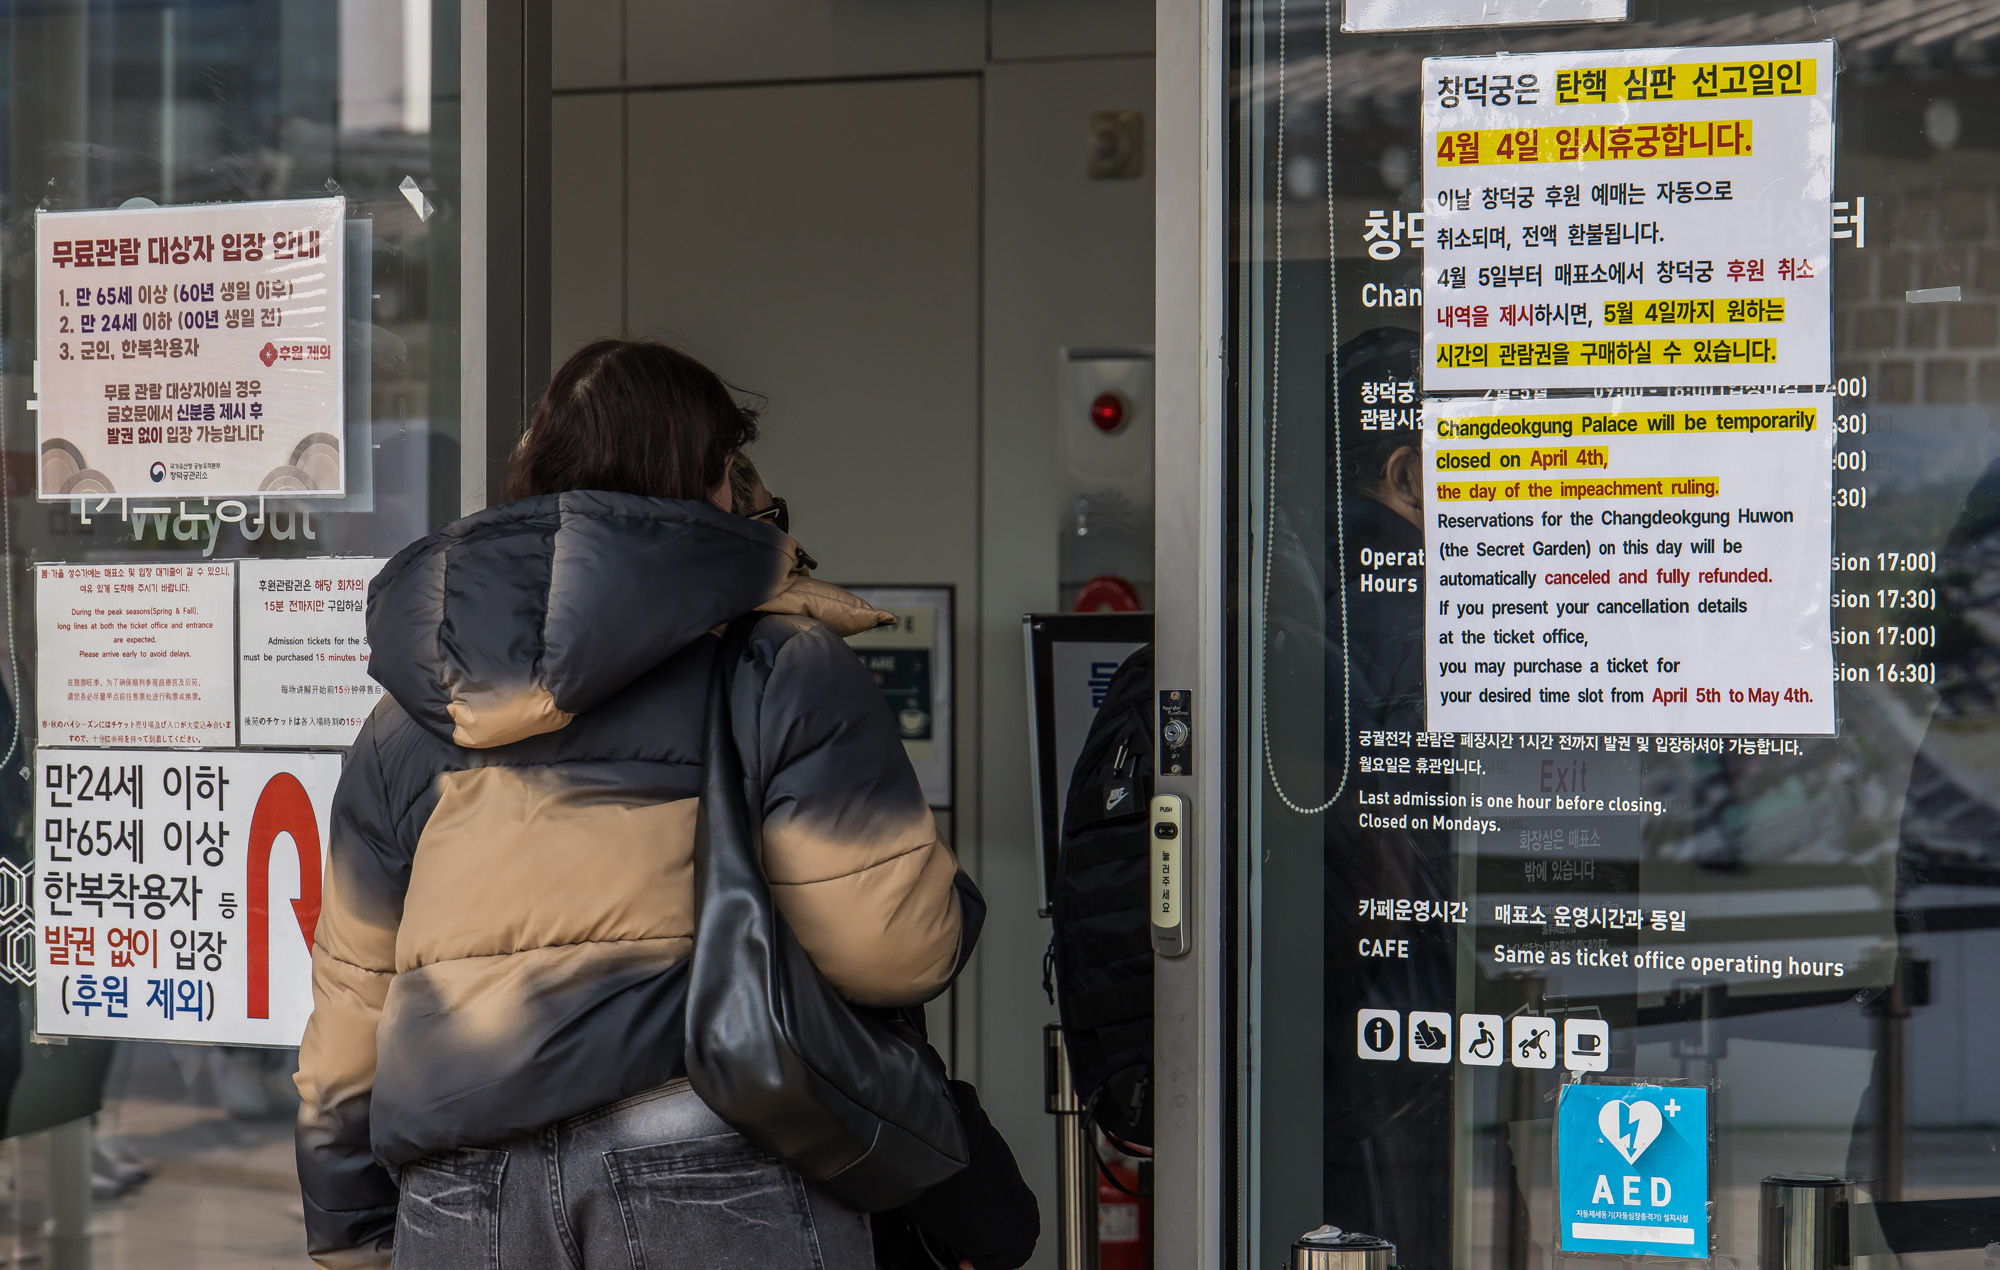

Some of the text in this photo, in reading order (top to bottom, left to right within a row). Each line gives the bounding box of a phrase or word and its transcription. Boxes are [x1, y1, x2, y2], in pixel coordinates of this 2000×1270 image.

[1438, 61, 1801, 108] 창덕궁은 탄핵 심판 선고일인
[1438, 122, 1751, 164] 4월 4일 임시휴궁합니다.
[1438, 181, 1733, 211] 이날 창덕궁 후원 예매는 자동으로
[53, 230, 319, 268] 무료관람 대상자 입장 안내
[1437, 226, 1511, 251] 취소되며,
[1523, 225, 1556, 247] 전액
[1568, 222, 1664, 246] 환불됩니다.
[1438, 258, 1814, 289] 4월 5일부터 매표소에서 창덕궁 후원 취소
[59, 280, 293, 306] 1. 만 65세 이상 (60년 생일 이후)
[60, 308, 282, 333] 2. 만 24세 이하 (00년 생일 전)
[1438, 299, 1784, 328] 내역을 제시하시면, 5월 4일까지 원하는
[60, 338, 199, 360] 3. 군인, 한복착용자
[279, 345, 330, 361] 후원 제외
[1437, 339, 1775, 367] 시간의 관람권을 구매하실 수 있습니다.
[105, 380, 261, 401] 무료 관람 대상자이실 경우
[108, 402, 262, 422] 금호문에서 신분증 제시 후
[1438, 418, 1572, 438] Changdeokgung
[1583, 416, 1637, 432] Palace
[1647, 414, 1674, 431] will
[1685, 414, 1706, 430] be
[1716, 411, 1815, 433] temporarily
[108, 425, 264, 444] 발권 없이 입장 가능합니다
[1437, 449, 1607, 470] closed on April 4th,
[170, 471, 207, 481] 창덕궁관리소
[1437, 479, 1718, 501] the day of the impeachment ruling.
[1878, 551, 1935, 573] 17:00)
[1361, 574, 1417, 592] Hours
[1877, 588, 1935, 610] 17:30)
[127, 635, 156, 645] expected.
[1877, 625, 1935, 647] 17:00)
[80, 649, 191, 659] Please arrive early to avoid delays.
[1877, 663, 1935, 684] 16:30)
[1359, 731, 1803, 755] 궁궐전각 관람은 폐장시간 1시간 전까지 발권 및 입장하셔야 가능합니다.
[1359, 756, 1485, 775] 월요일은 휴관입니다.
[1541, 759, 1587, 792] Exit
[46, 764, 229, 811] 만24세 이하
[1360, 790, 1666, 816] Last admission is one hour before closing.
[1359, 813, 1500, 834] Closed on Mondays.
[46, 818, 229, 867] 만65세 이상
[1520, 829, 1600, 851] 화장실은 매표소
[1161, 850, 1170, 913] 눌러주세요
[1525, 859, 1595, 882] 밖에 있습니다
[44, 872, 237, 920] 한복착용자 등
[1359, 898, 1468, 923] 카페운영시간
[1495, 904, 1547, 924] 매표소
[1554, 906, 1643, 930] 운영시간과
[1650, 910, 1685, 931] 동일
[45, 926, 227, 971] 발권 없이 입장
[1359, 939, 1408, 958] CAFE
[1494, 945, 1545, 964] Same
[1551, 952, 1571, 965] as
[1576, 948, 1628, 967] ticket
[1634, 951, 1685, 970] office
[1691, 955, 1782, 978] operating
[1789, 957, 1844, 976] hours
[62, 975, 214, 1022] (후원 제외)
[1592, 1175, 1671, 1206] AED
[1664, 1213, 1688, 1224] 설치시설
